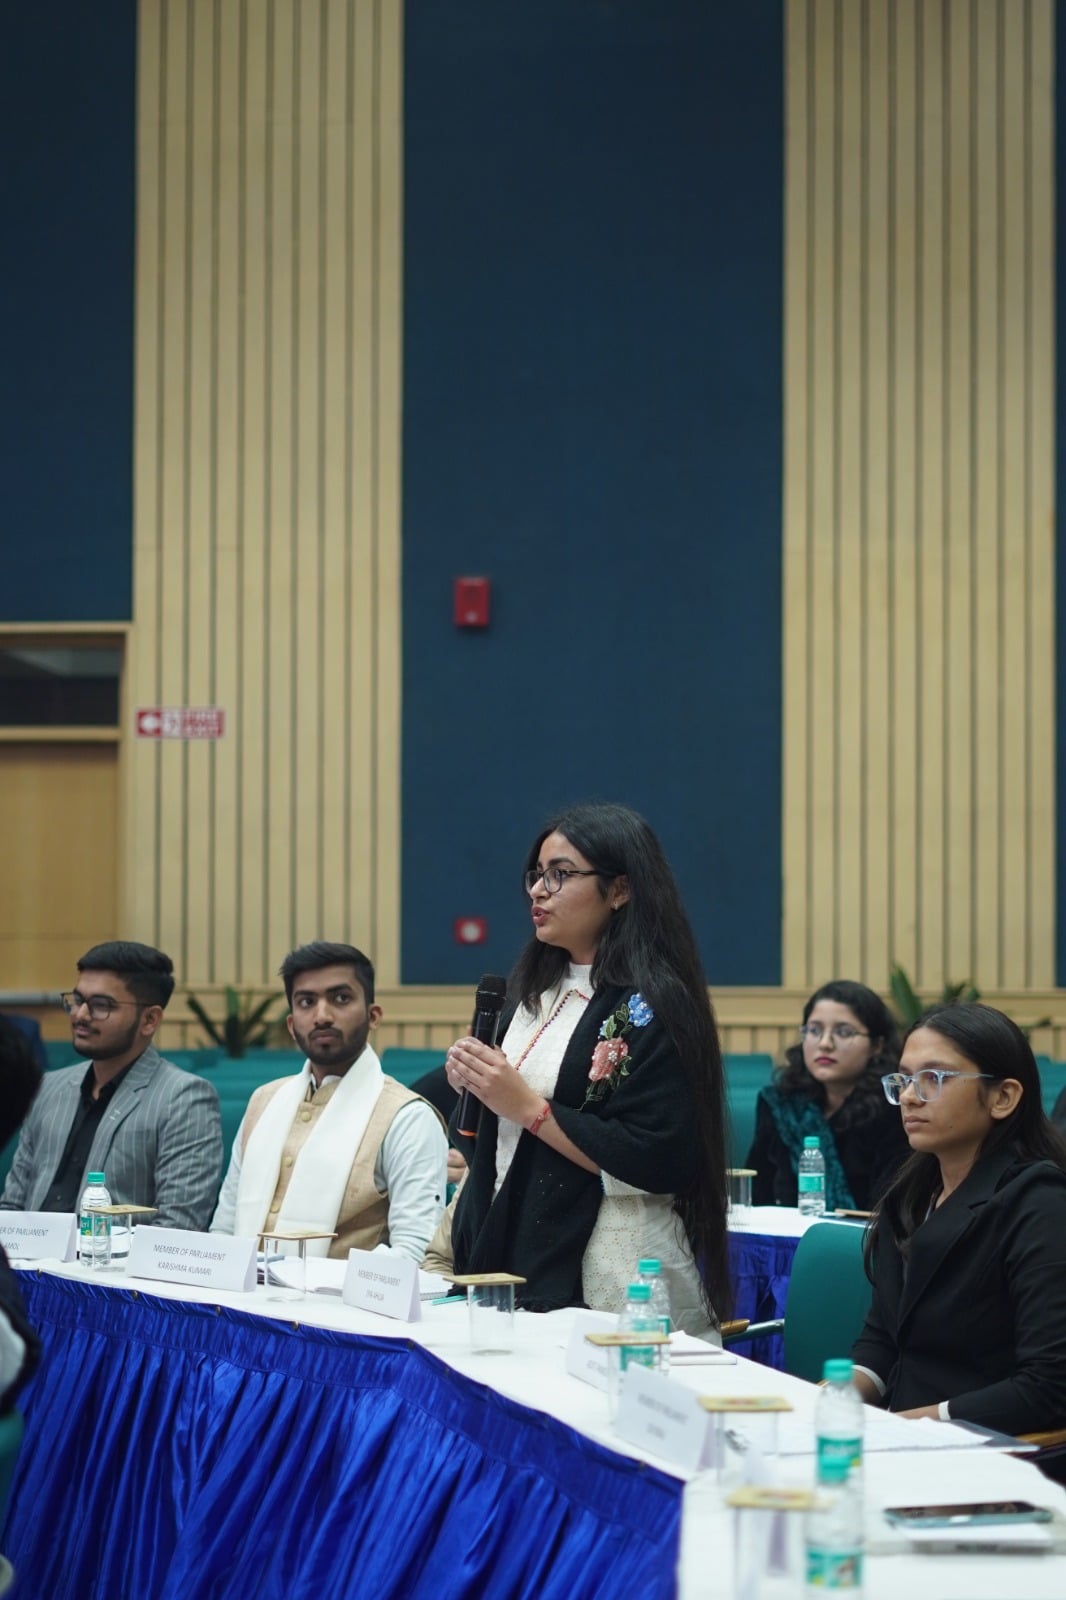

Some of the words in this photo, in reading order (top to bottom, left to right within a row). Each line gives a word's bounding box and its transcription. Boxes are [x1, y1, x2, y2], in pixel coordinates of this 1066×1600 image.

[154, 1244, 180, 1255] MEMBER
[180, 1248, 189, 1256] OF
[189, 1249, 226, 1261] PARLIAMENT
